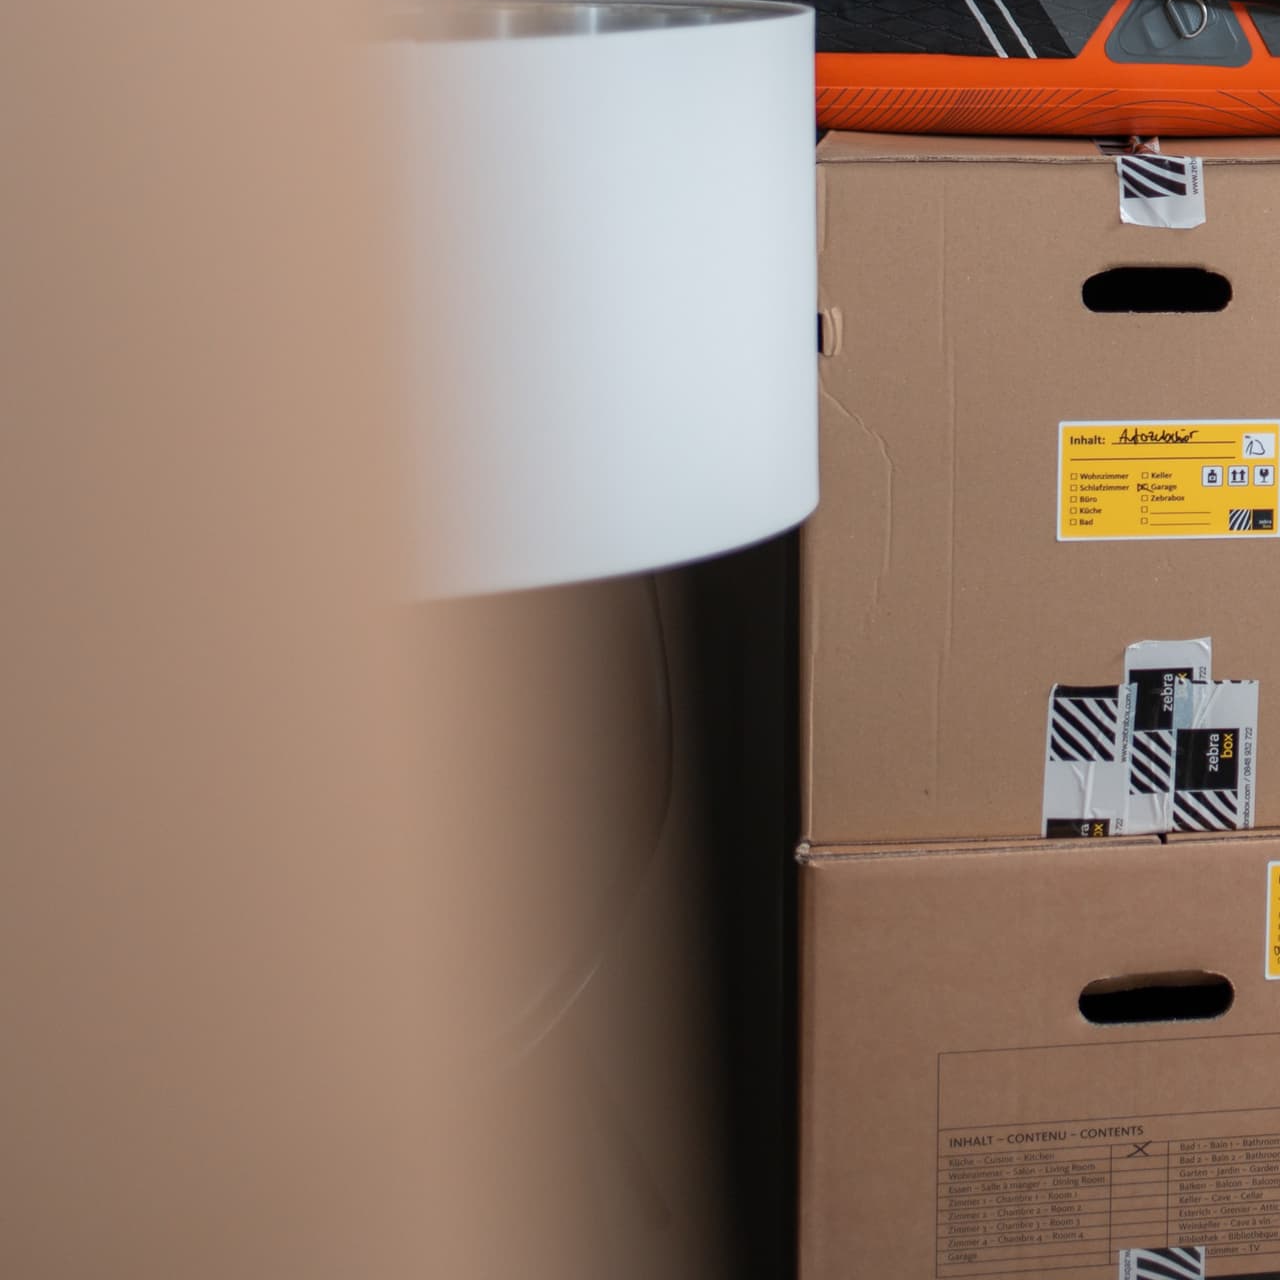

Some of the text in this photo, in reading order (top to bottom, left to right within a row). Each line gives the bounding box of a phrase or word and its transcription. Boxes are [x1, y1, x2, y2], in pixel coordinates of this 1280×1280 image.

[1070, 435, 1105, 445] Inhalt:
[1161, 673, 1174, 712] zebra
[1206, 733, 1220, 772] zebra
[1220, 733, 1233, 759] box
[950, 1125, 1144, 1148] INHALT CONTENU CONTENTS
